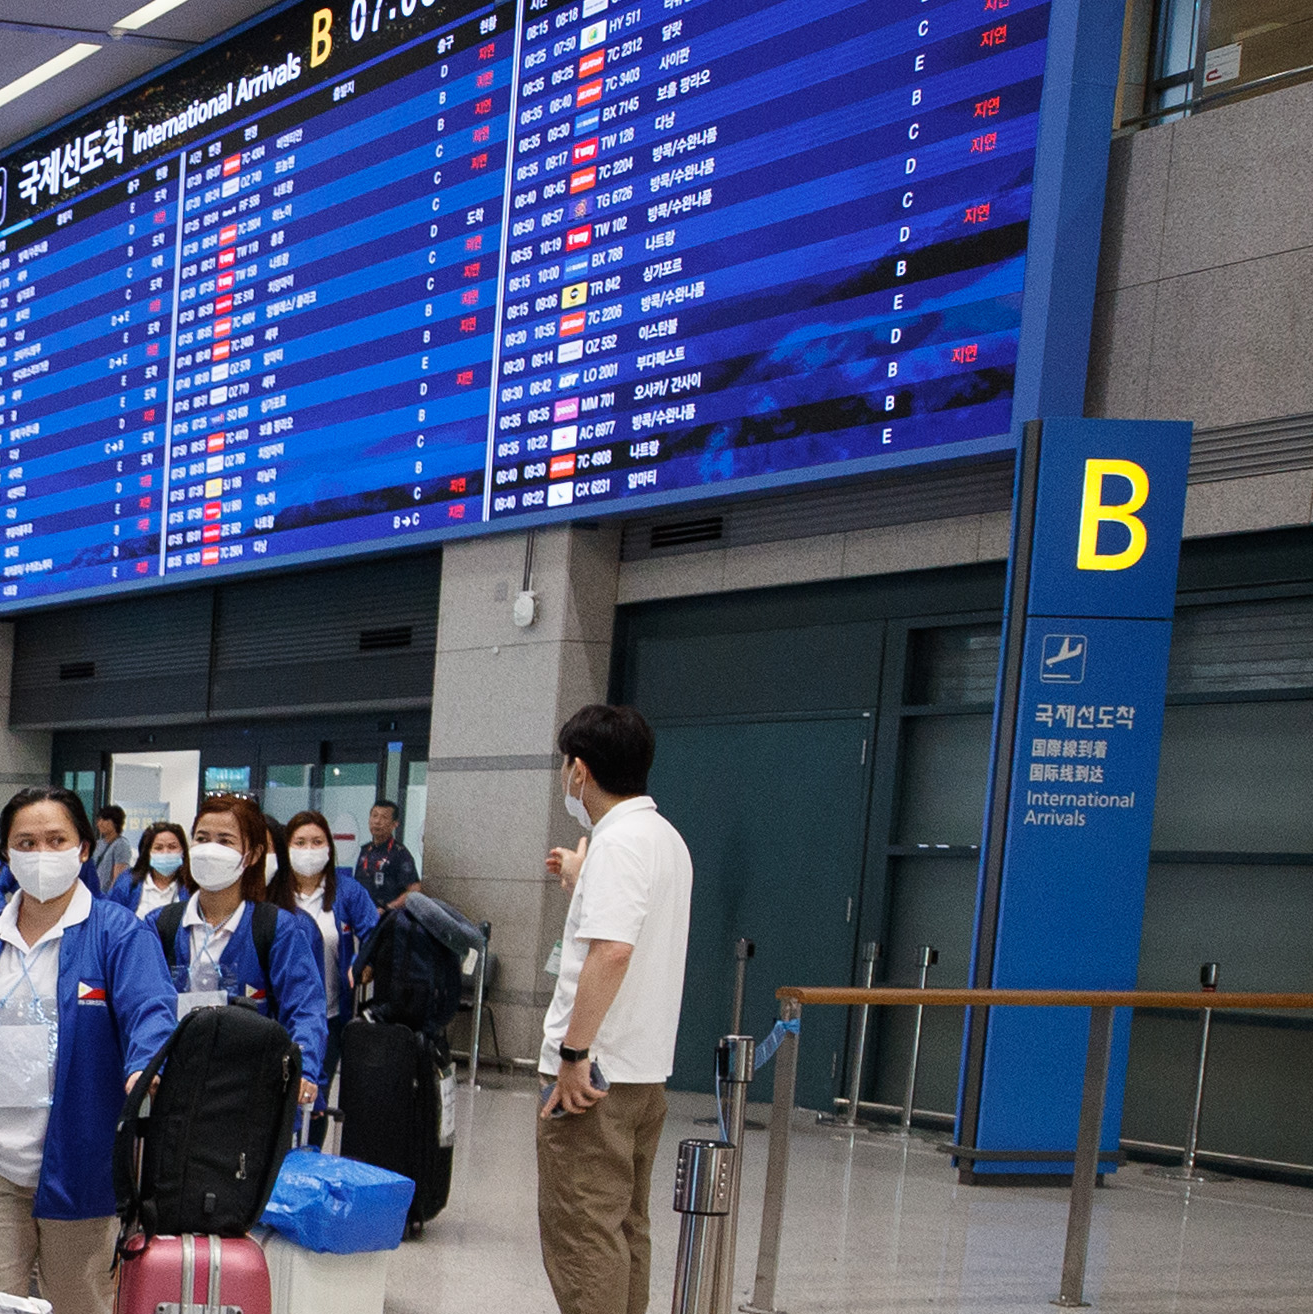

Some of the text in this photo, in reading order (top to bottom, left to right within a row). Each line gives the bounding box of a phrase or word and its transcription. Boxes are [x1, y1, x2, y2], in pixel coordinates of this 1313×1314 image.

[609, 15, 624, 32] HY
[607, 45, 619, 62] 7C
[440, 64, 448, 77] D
[605, 75, 617, 91] 7C
[658, 46, 690, 69] 사이판
[601, 133, 617, 149] TW
[655, 111, 675, 129] 다낭
[918, 19, 928, 35] C
[439, 91, 446, 104] B
[598, 163, 611, 179] 7C
[652, 125, 717, 162] 방콕/수완나품
[915, 53, 924, 71] E
[980, 24, 1006, 46] 지연
[17, 117, 129, 205] 국제선도착
[132, 84, 232, 155] International
[234, 53, 301, 107] Arrivals
[308, 8, 332, 67] B
[602, 104, 616, 121] BX
[437, 117, 444, 131] B
[435, 143, 443, 157] C
[596, 192, 610, 207] TG
[650, 157, 714, 192] 방콕/수완나품
[912, 88, 921, 105] B
[594, 221, 610, 237] TW
[647, 188, 712, 222] 방콕/수완나품
[908, 122, 918, 139] C
[974, 96, 1000, 117] 지연
[434, 171, 441, 184] C
[432, 197, 439, 211] C
[591, 251, 605, 267] BX
[645, 229, 675, 250] 나트랑
[905, 157, 916, 173] D
[970, 132, 996, 152] 지연
[466, 207, 484, 224] 도착
[430, 224, 437, 237] D
[590, 280, 603, 295] TR
[643, 257, 682, 281] 싱가포르
[902, 191, 913, 207] C
[428, 250, 436, 263] C
[588, 309, 600, 324] 7C
[640, 280, 705, 311] 방콕/수완나품
[899, 226, 910, 242] D
[963, 203, 989, 223] 지연
[426, 277, 434, 290] C
[424, 303, 432, 316] B
[585, 337, 600, 354] OZ
[638, 317, 677, 339] 이스탄불
[896, 260, 906, 275] B
[423, 329, 430, 343] B
[583, 367, 597, 382] LO
[636, 345, 684, 370] 부다페스트
[893, 293, 903, 309] E
[421, 356, 428, 369] E
[581, 395, 598, 410] MM
[633, 378, 669, 399] 오사카/
[671, 371, 701, 392] 간사이
[890, 328, 901, 343] D
[420, 382, 427, 395] D
[579, 424, 593, 440] AC
[632, 403, 695, 430] 방콕/수완나품
[888, 361, 897, 377] B
[951, 343, 977, 363] 지연
[417, 408, 425, 422] B
[577, 453, 589, 468] 7C
[630, 439, 659, 458] 나트랑
[885, 394, 894, 410] B
[416, 434, 424, 447] C
[415, 460, 422, 473] B
[575, 482, 589, 497] CX
[882, 427, 891, 443] E
[413, 486, 421, 499] C
[393, 512, 419, 528] B C
[1077, 458, 1150, 571] B
[1034, 704, 1136, 730] 국제선도착
[1031, 739, 1108, 759] 国際線到着
[1029, 764, 1104, 783] 国际线到达
[1027, 790, 1134, 809] International
[1024, 808, 1086, 827] Arrivals
